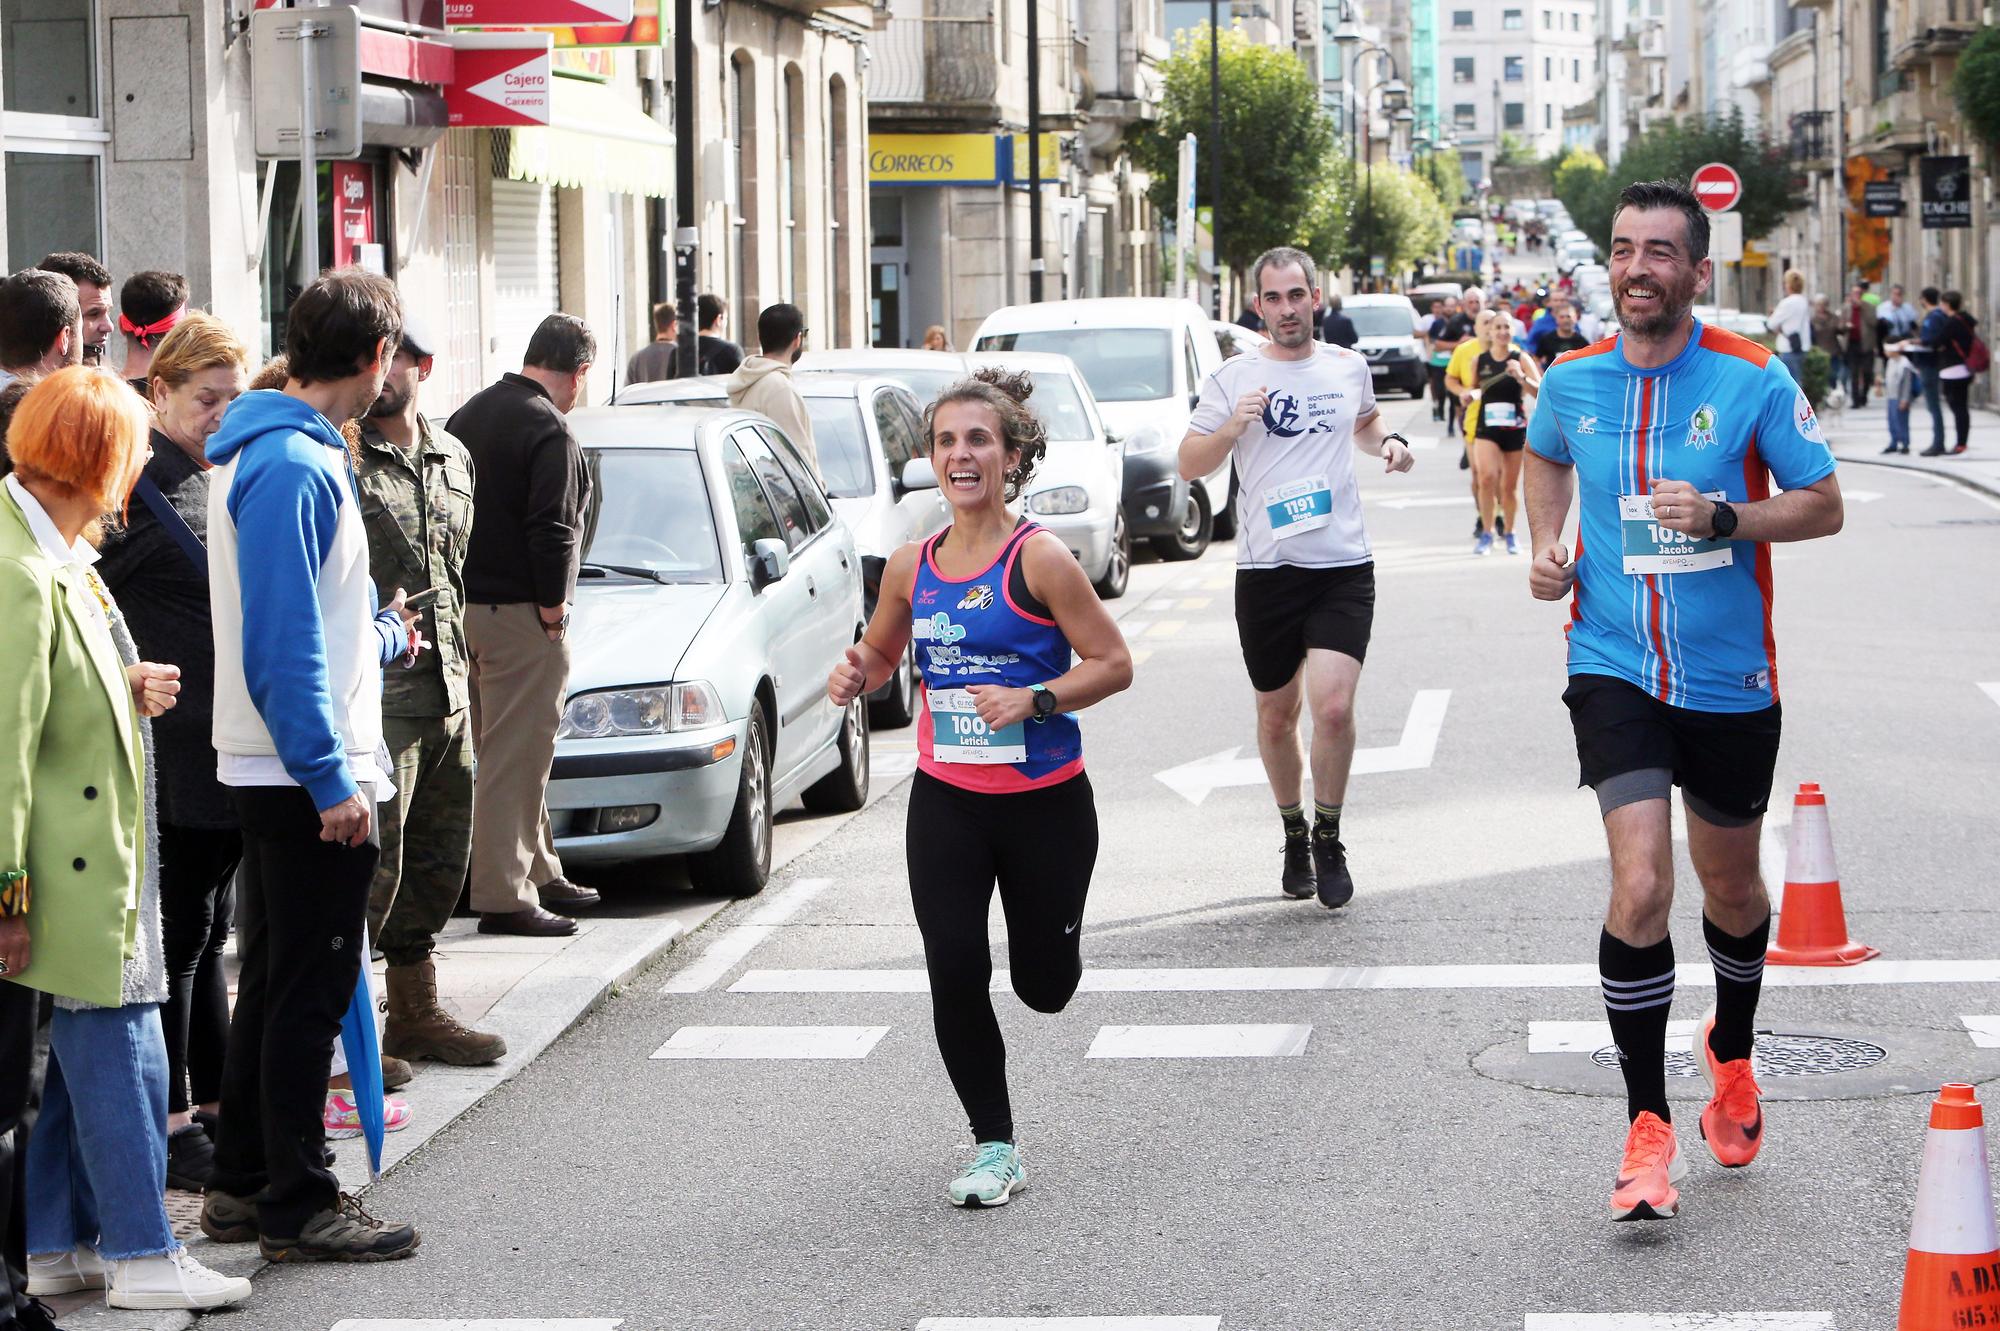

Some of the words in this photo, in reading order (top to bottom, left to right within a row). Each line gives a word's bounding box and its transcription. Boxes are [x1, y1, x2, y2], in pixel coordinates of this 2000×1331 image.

[504, 72, 545, 88] Cajero
[504, 96, 544, 106] Caixeiro
[870, 150, 954, 173] CORREOS
[1307, 392, 1344, 402] NOCTURNA
[1284, 495, 1316, 516] 1191
[1291, 511, 1313, 522] Diego
[1658, 544, 1695, 555] Jacobo
[951, 715, 996, 736] 100
[960, 735, 990, 746] Leticia
